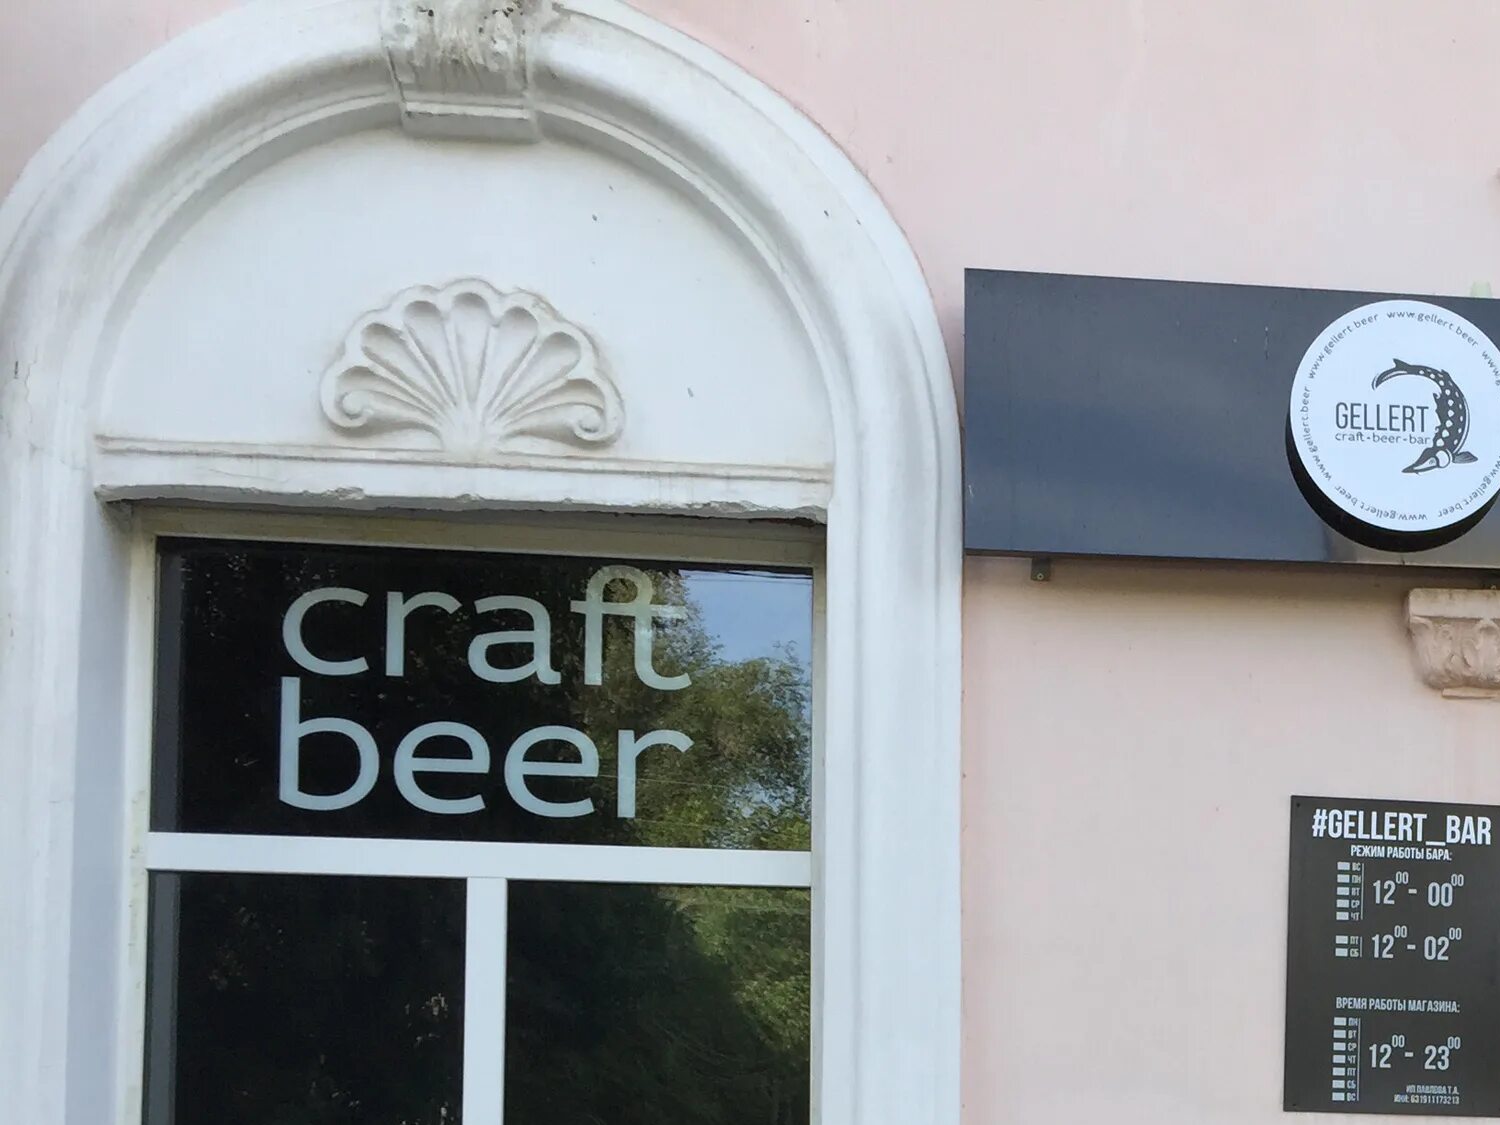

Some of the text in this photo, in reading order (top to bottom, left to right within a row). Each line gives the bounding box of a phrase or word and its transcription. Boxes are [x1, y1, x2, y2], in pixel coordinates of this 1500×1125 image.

[1335, 402, 1429, 433] GELLERT
[282, 565, 692, 691] craft
[279, 676, 694, 819] beer
[1350, 845, 1452, 861] РЕЖИМ РАБОТЫ БАРА:
[1336, 997, 1460, 1013] ВРЕМЯ РАБОТЫ МАГАЗИНА:
